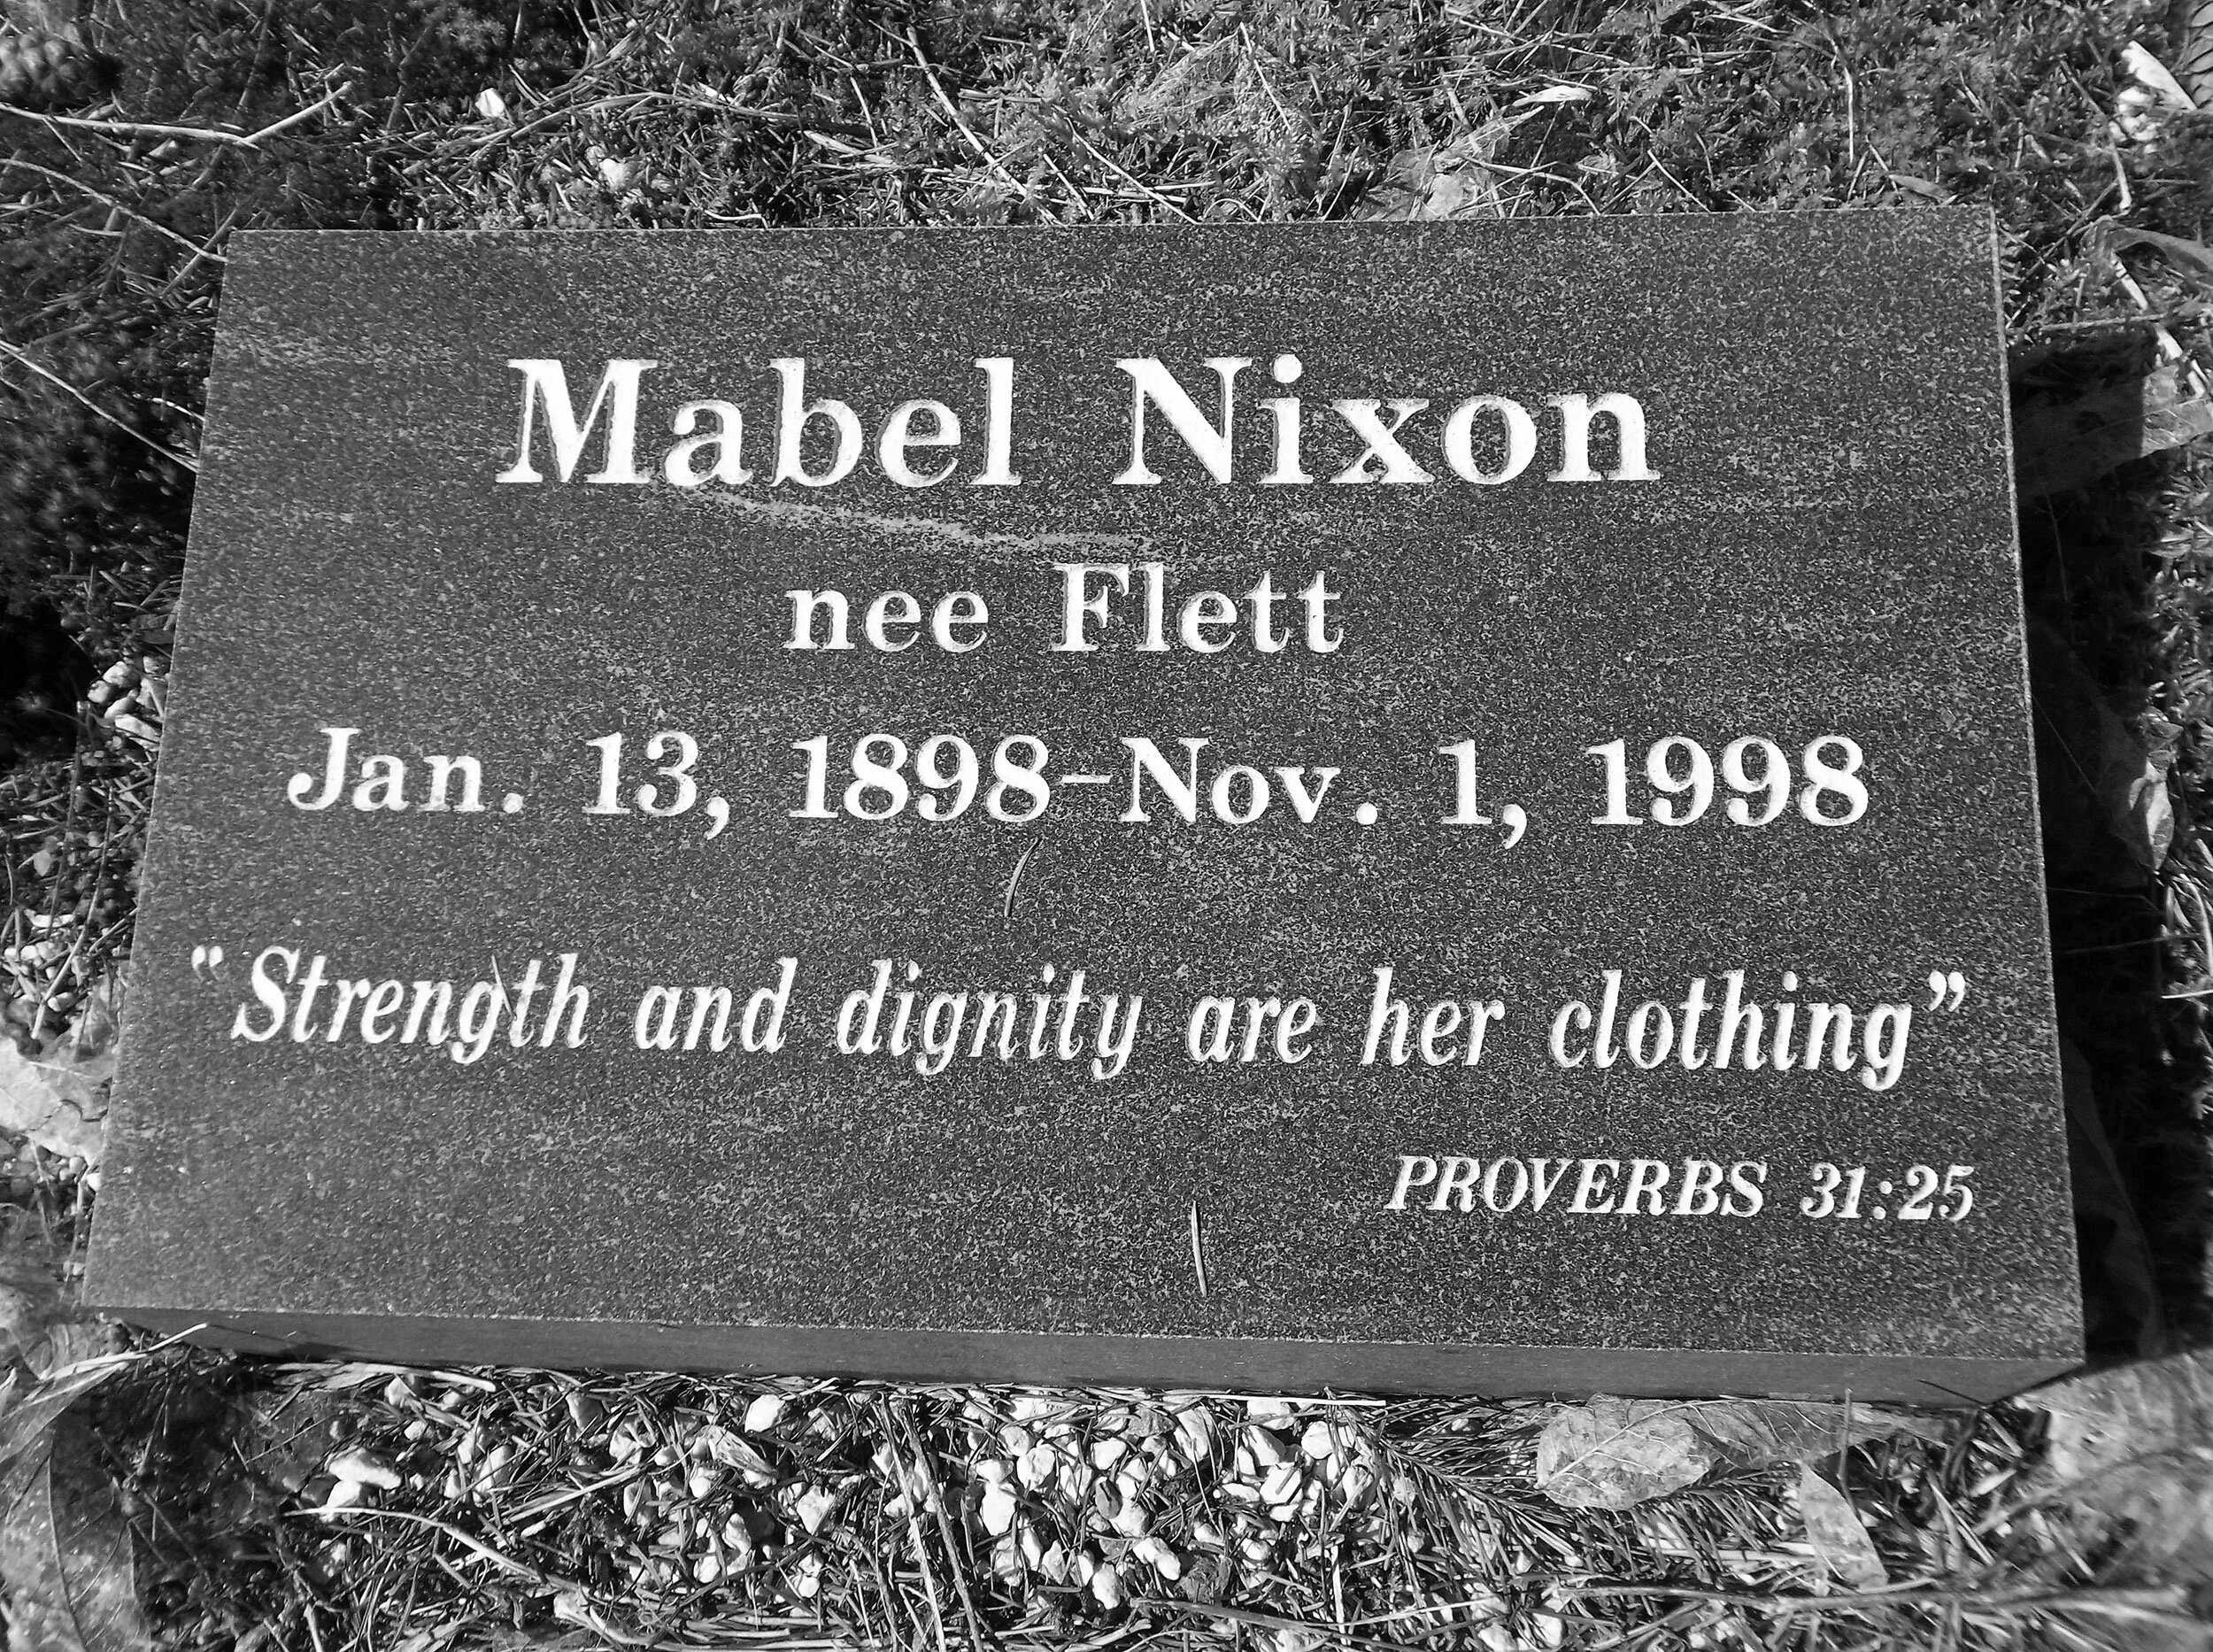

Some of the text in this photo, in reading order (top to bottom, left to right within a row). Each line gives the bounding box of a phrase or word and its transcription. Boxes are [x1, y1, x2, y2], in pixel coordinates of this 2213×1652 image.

[497, 354, 1661, 490] Mabel Nixon
[784, 562, 1343, 653] nee Flett
[288, 727, 523, 814] Jan.
[583, 730, 729, 839] 13,
[1439, 740, 1526, 848] 1,
[1586, 735, 1869, 826] 1998
[191, 946, 1966, 1092] "Strength and dignity are her clothing"
[1384, 1156, 1975, 1221] PROVERBS 31:25
